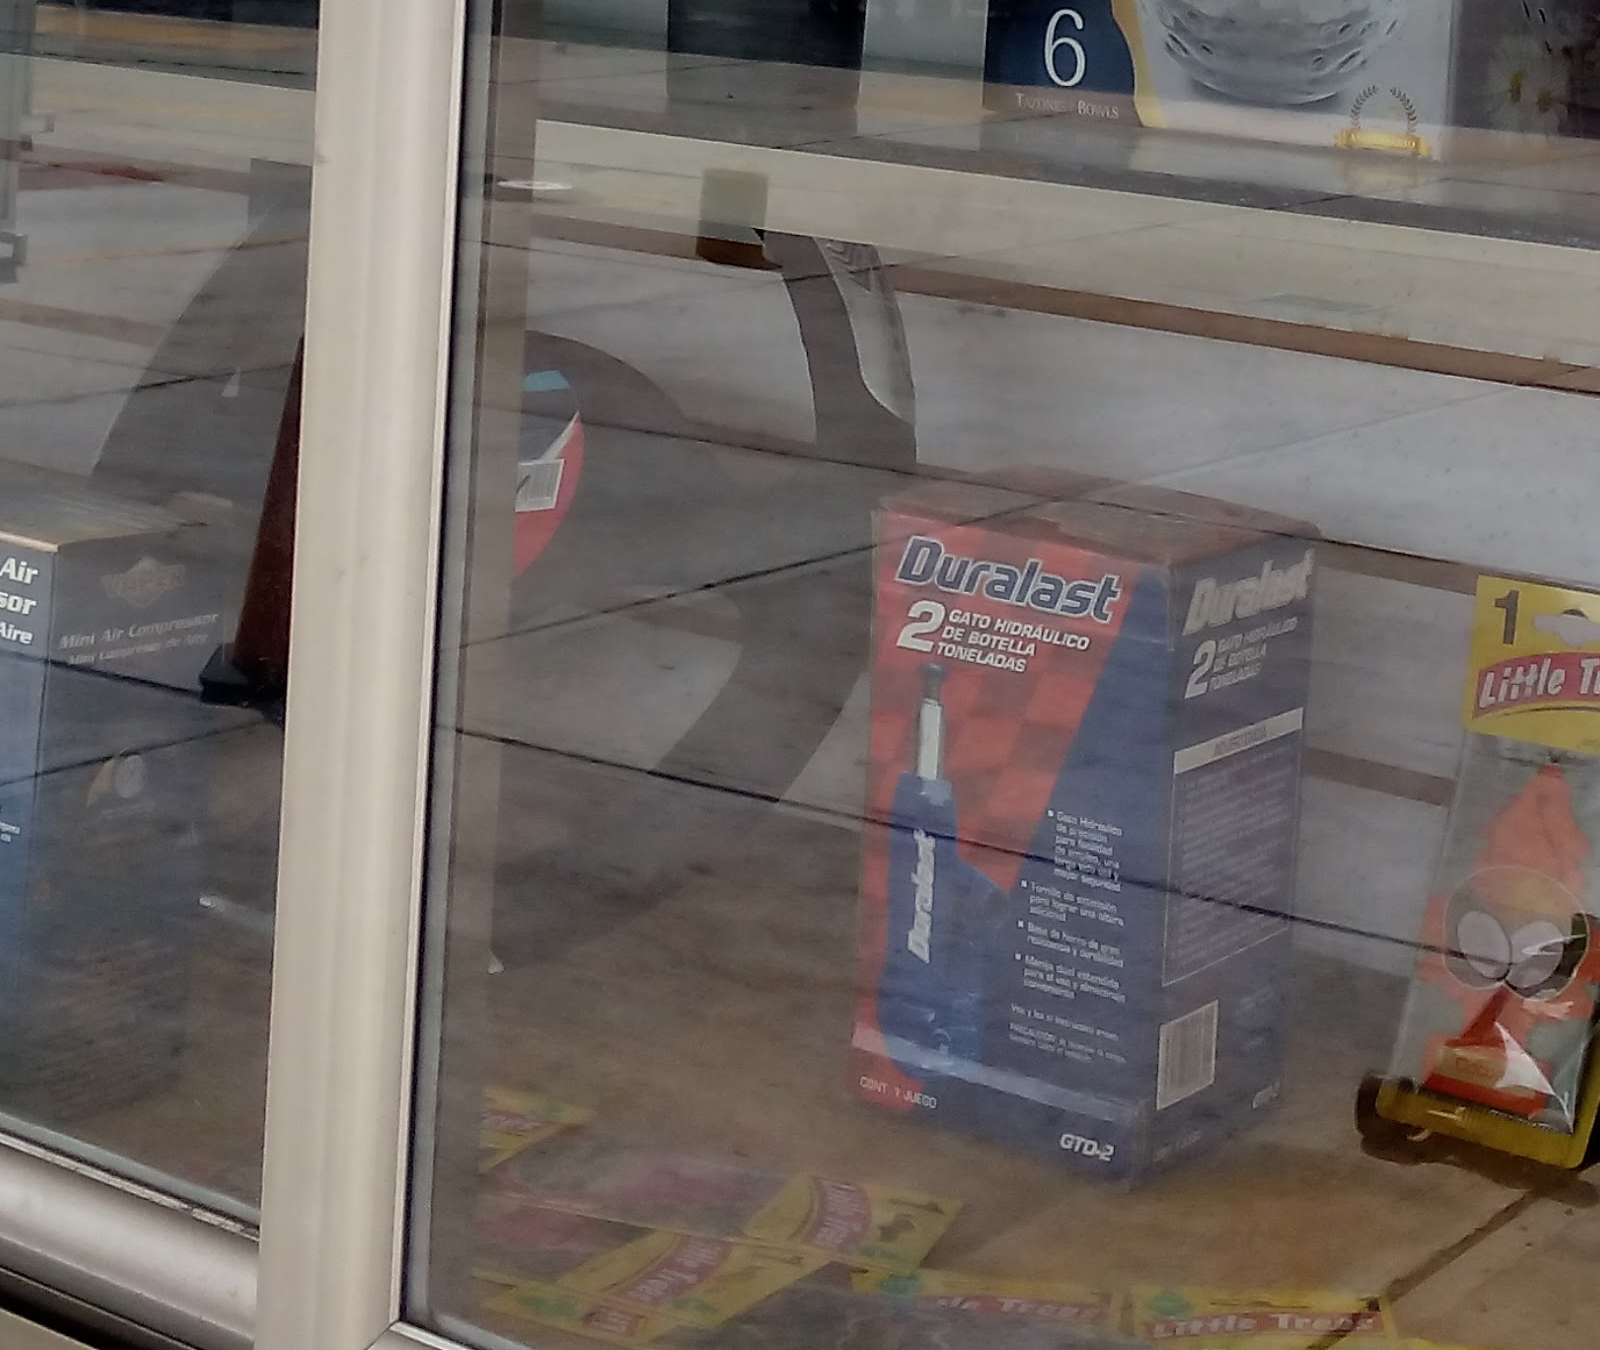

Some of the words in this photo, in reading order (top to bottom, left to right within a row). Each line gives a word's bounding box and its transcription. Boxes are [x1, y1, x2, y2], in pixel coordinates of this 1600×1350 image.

[1043, 7, 1087, 88] 6
[895, 535, 1122, 624] Duralast
[896, 600, 946, 652] 2
[949, 609, 992, 629] GATO
[994, 618, 1091, 650] HIDRÁULICO
[1494, 589, 1520, 645] 1
[59, 632, 97, 650] Mini
[936, 642, 1027, 673] TONELADAS
[942, 625, 964, 642] DE
[968, 632, 1036, 657] BOTELLA
[1184, 639, 1216, 699] 2
[1477, 657, 1566, 709] Little
[903, 1087, 937, 1109] JUEGO
[1060, 1133, 1115, 1162] GTD-2
[1154, 1315, 1258, 1338] Little
[1276, 1313, 1376, 1333] Trees
